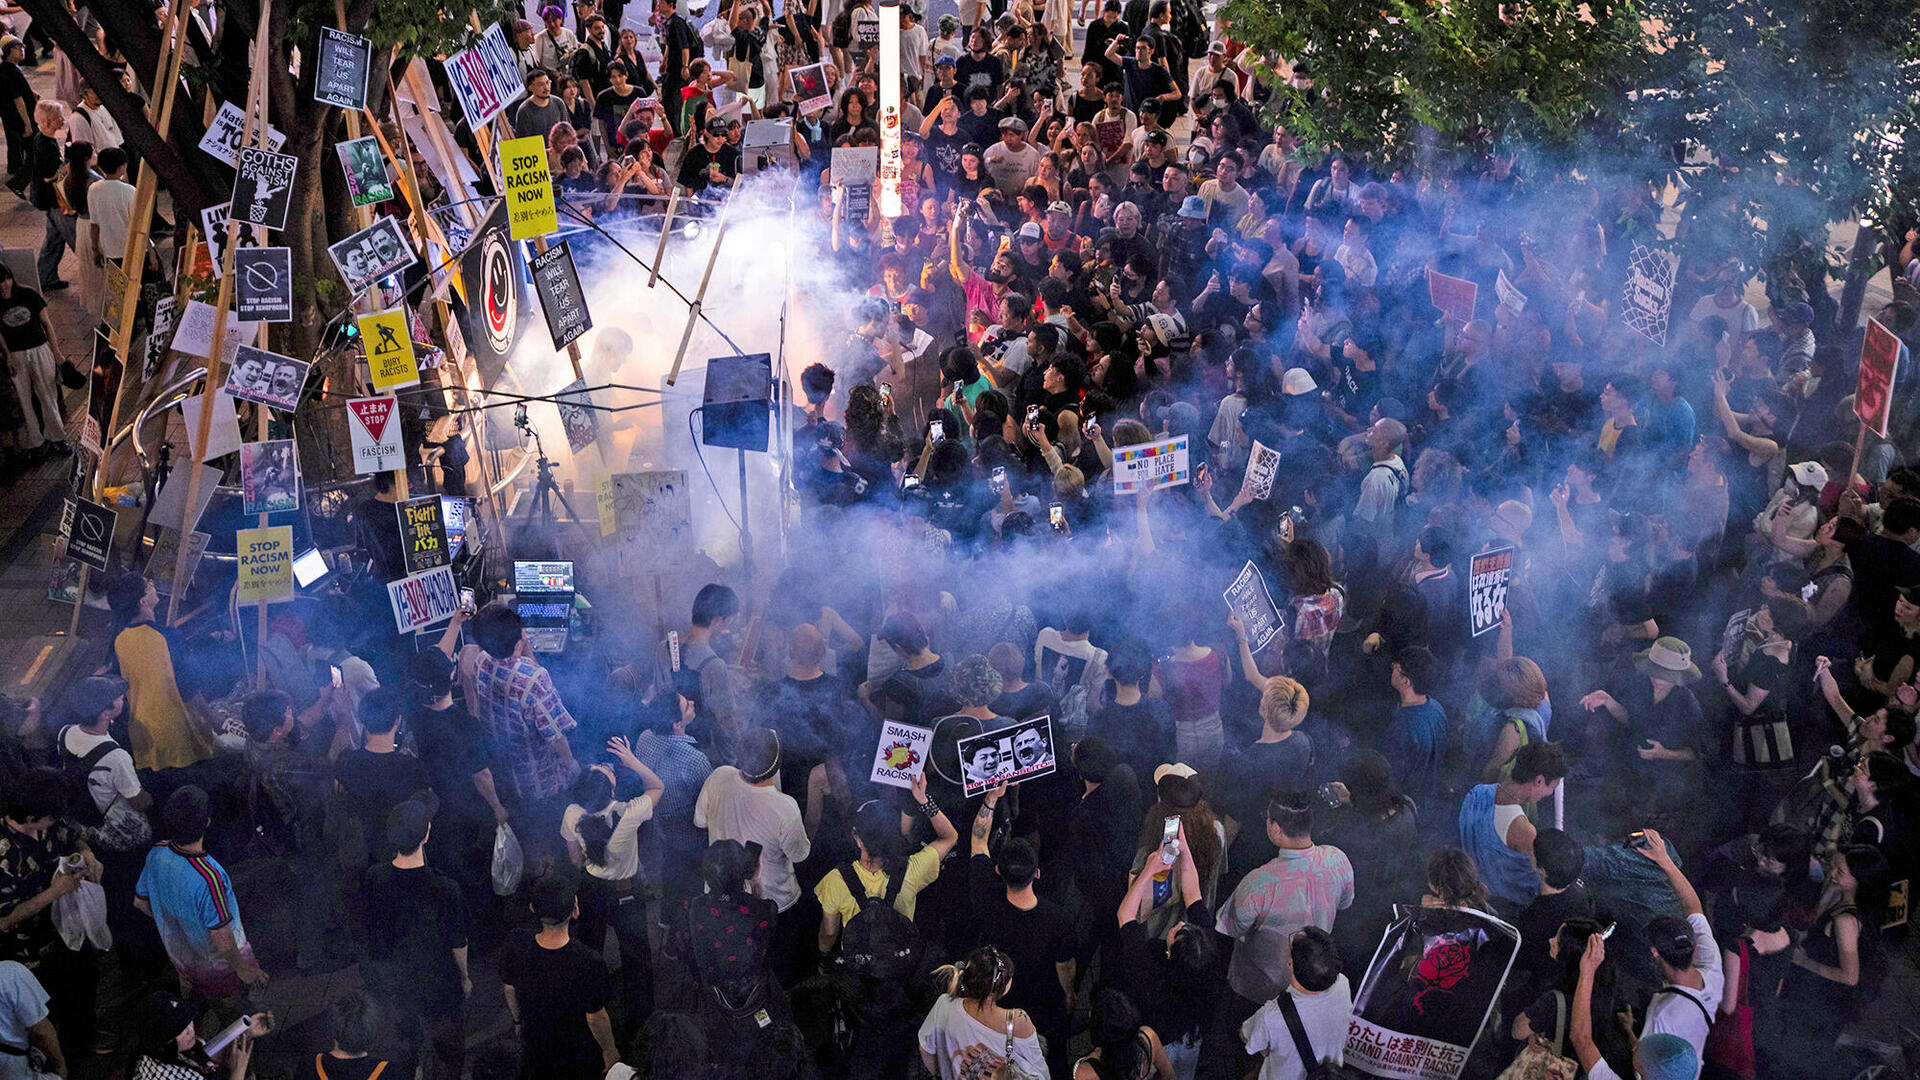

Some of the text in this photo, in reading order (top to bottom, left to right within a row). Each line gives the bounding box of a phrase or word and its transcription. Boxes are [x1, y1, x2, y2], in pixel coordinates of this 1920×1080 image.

[329, 31, 362, 46] RACISM
[334, 44, 355, 57] WILL
[333, 56, 355, 69] TEAR
[336, 70, 348, 80] US
[327, 81, 354, 93] APART
[327, 93, 353, 105] AGAIN
[241, 149, 295, 172] GOTHS
[512, 154, 539, 171] STOP
[241, 162, 292, 179] AGAINST
[506, 170, 549, 189] RACISM
[354, 189, 392, 205] RACISM
[517, 187, 543, 203] NOW
[534, 245, 564, 269] RACISM
[544, 264, 564, 281] WILL
[549, 279, 570, 297] TEAR
[558, 297, 570, 309] US
[558, 307, 580, 329] APART
[562, 323, 585, 344] AGAIN
[382, 357, 401, 369] BURY
[379, 364, 409, 379] RACISTS
[360, 402, 388, 416] 止まれ
[364, 415, 386, 426] STOP
[361, 445, 396, 457] FASCISM
[1137, 453, 1175, 470] NO PLACE
[1154, 462, 1175, 476] HATE
[249, 541, 280, 552] STOP
[414, 536, 439, 552] バカ
[241, 552, 289, 566] RACISM
[250, 564, 280, 576] NOW
[1231, 568, 1252, 597] RACISM
[1249, 607, 1258, 619] US
[1472, 583, 1507, 628] なるな
[1251, 613, 1268, 636] APART
[1256, 625, 1274, 647] AGAIN
[886, 726, 927, 742] SMASH
[994, 767, 1009, 778] NAZI
[966, 781, 984, 790] STOP
[1348, 1020, 1466, 1063] わたしは差別に抗う
[1347, 1036, 1382, 1060] STAND
[1382, 1049, 1424, 1069] AGAINST
[1422, 1058, 1461, 1076] RACISM
